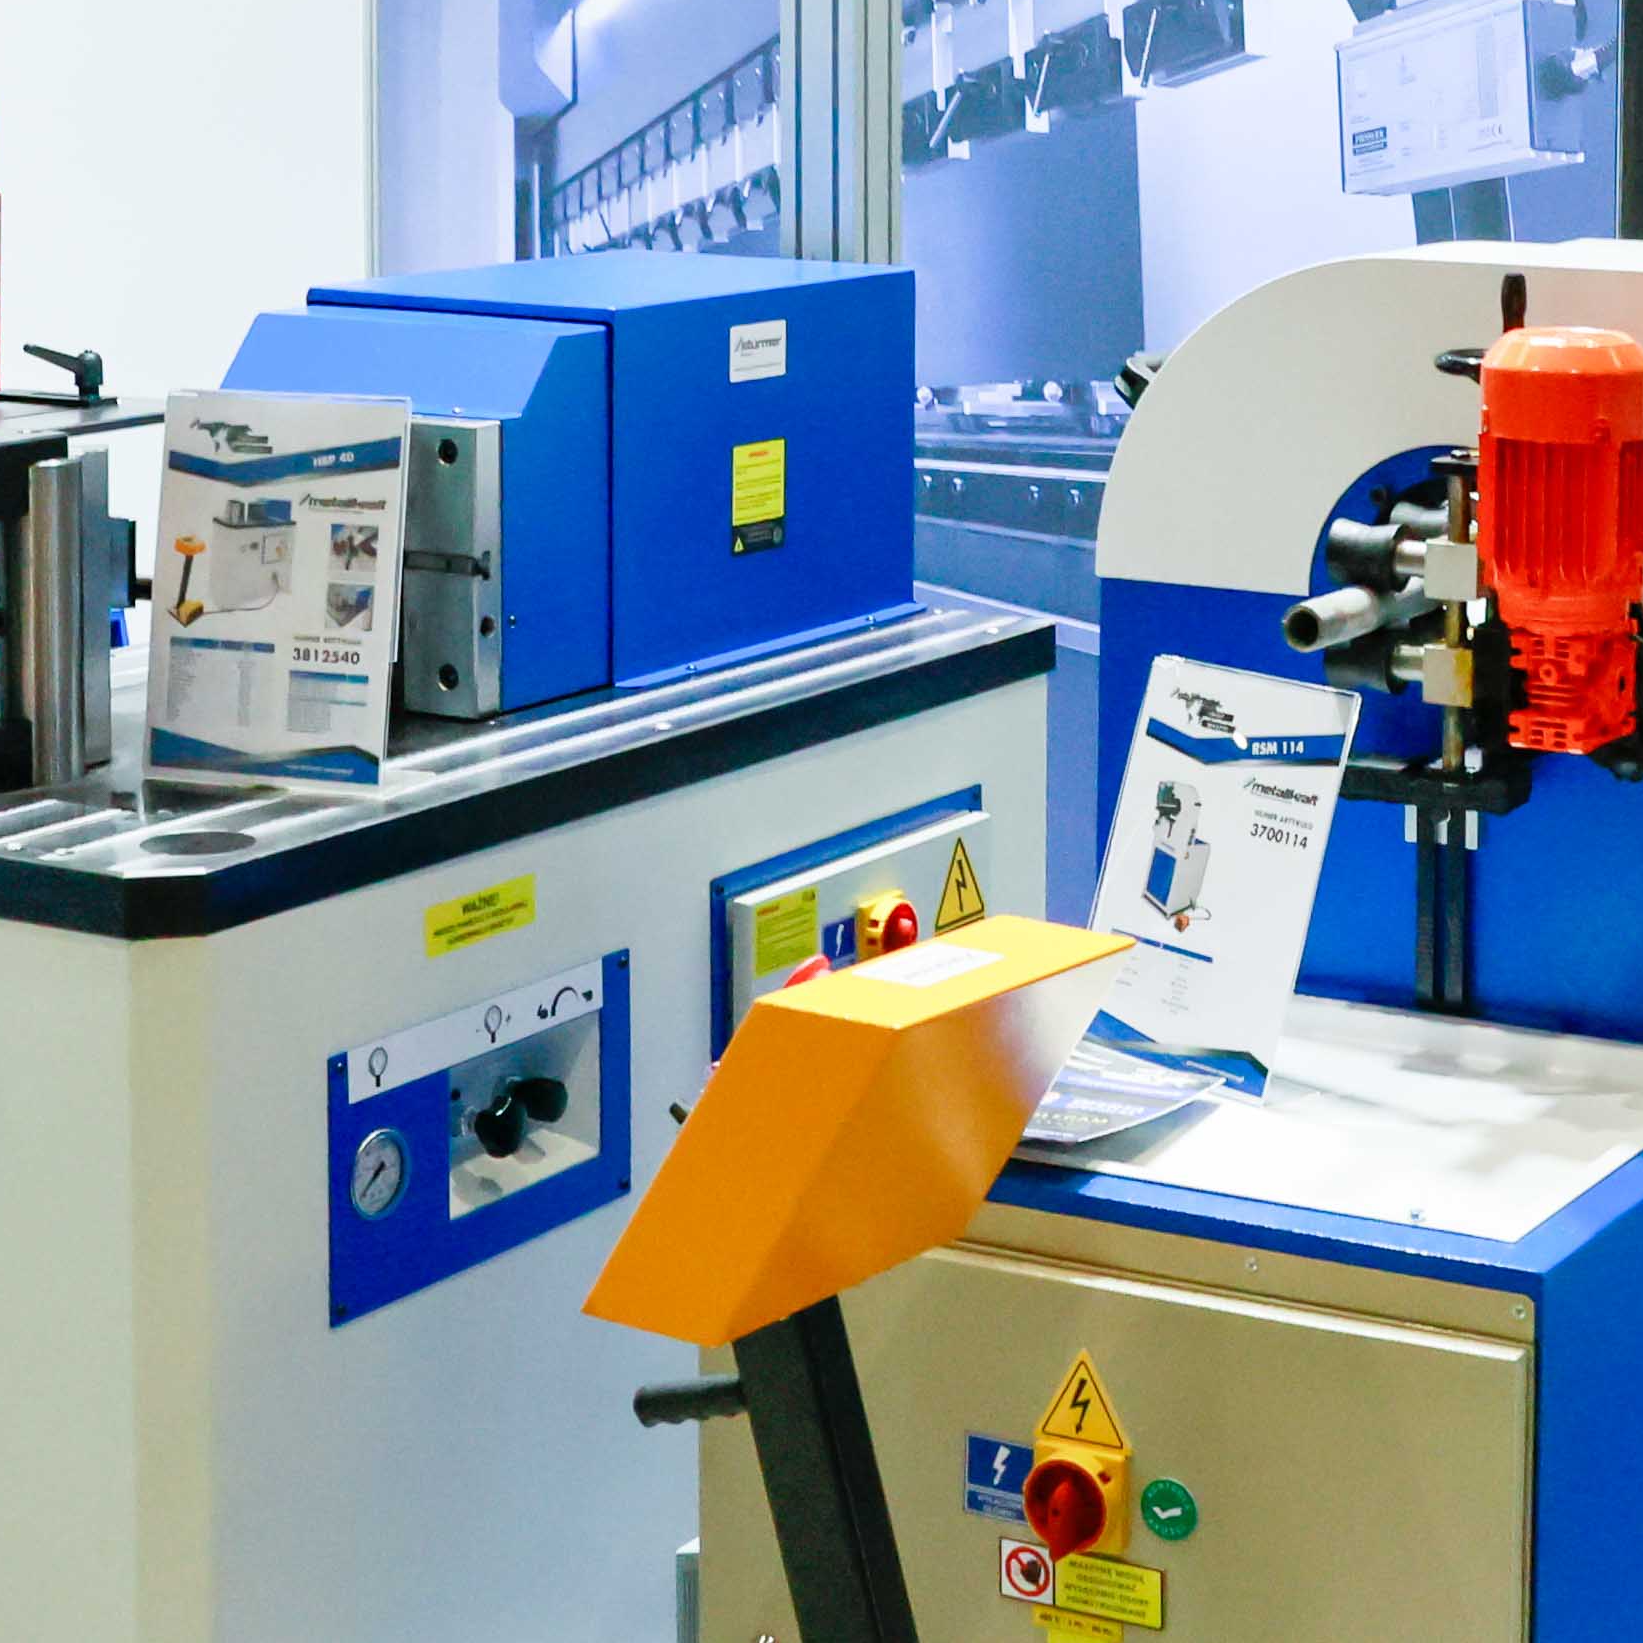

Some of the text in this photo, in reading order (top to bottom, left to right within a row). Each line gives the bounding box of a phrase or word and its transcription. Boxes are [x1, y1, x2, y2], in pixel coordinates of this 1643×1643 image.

[292, 647, 361, 665] 3812540
[1251, 740, 1305, 756] RSM 114
[1250, 823, 1308, 849] 3700114
